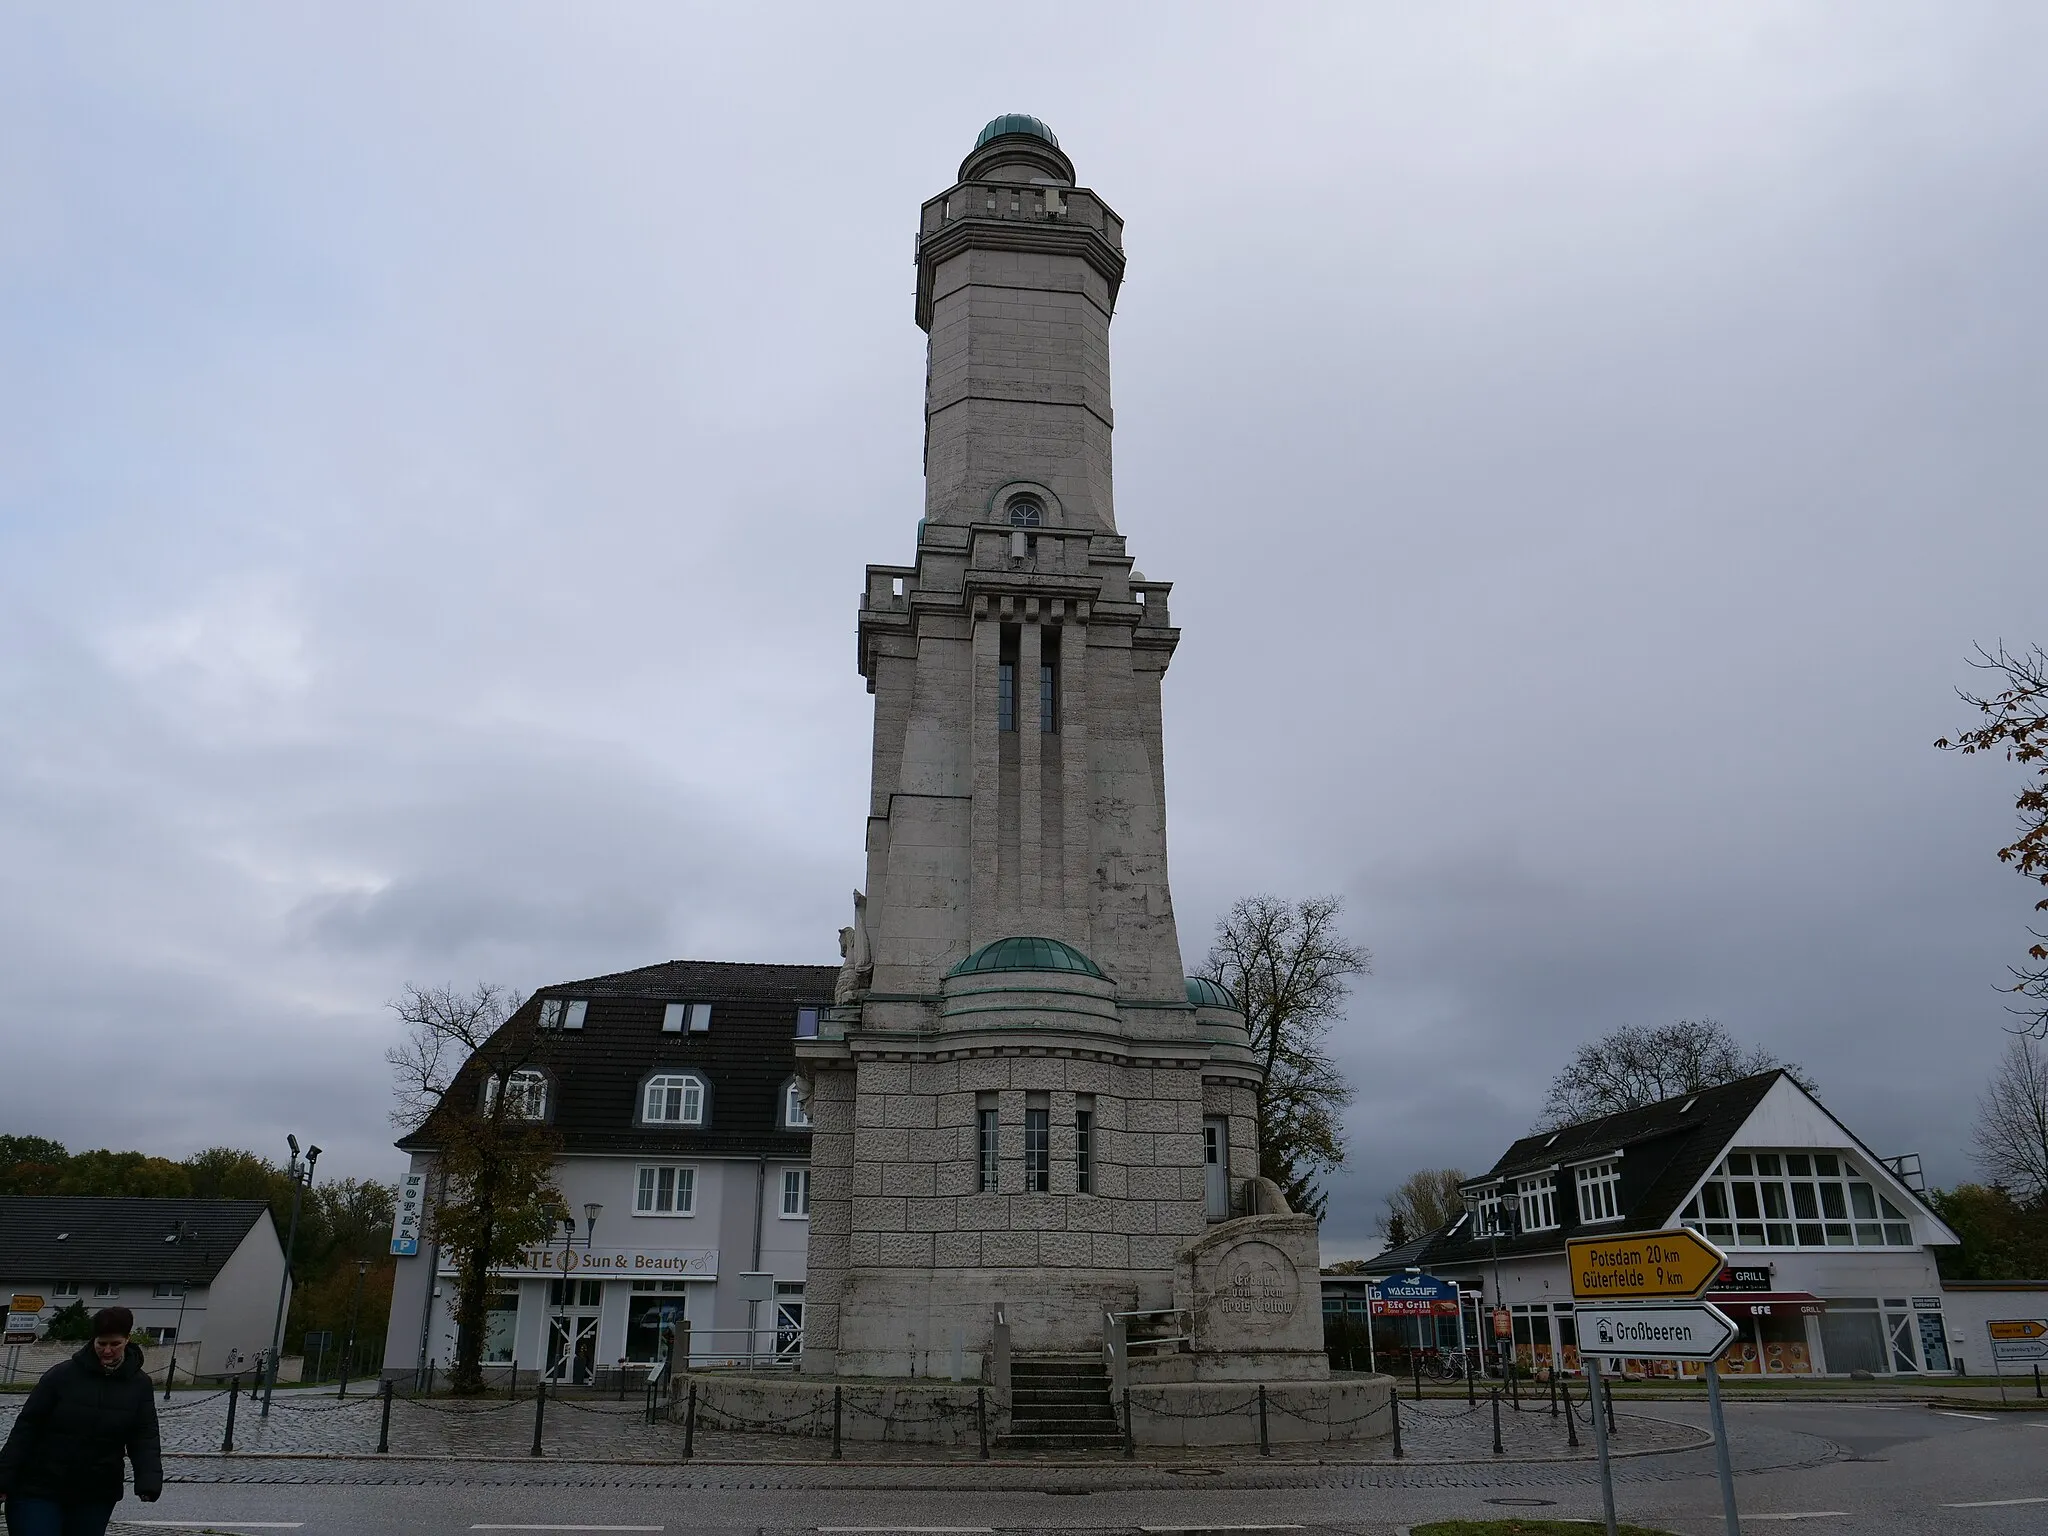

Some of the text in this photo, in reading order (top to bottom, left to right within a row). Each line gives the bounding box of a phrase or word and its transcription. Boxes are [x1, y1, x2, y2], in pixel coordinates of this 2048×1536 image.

[400, 1176, 421, 1239] HOTEL
[582, 1254, 611, 1267] Sun
[615, 1255, 628, 1268] &
[635, 1255, 688, 1272] Beauty
[1590, 1245, 1680, 1267] Potsdam 20 km
[1234, 1275, 1275, 1287] Erbaut
[1582, 1267, 1683, 1288] Güterfelde 9 km
[1735, 1271, 1766, 1281] GRILL
[1387, 1287, 1438, 1296] WAKESTUFF
[1387, 1301, 1431, 1309] Efe Grill
[1750, 1305, 1772, 1315] EFE
[1616, 1321, 1692, 1341] Großbeeren
